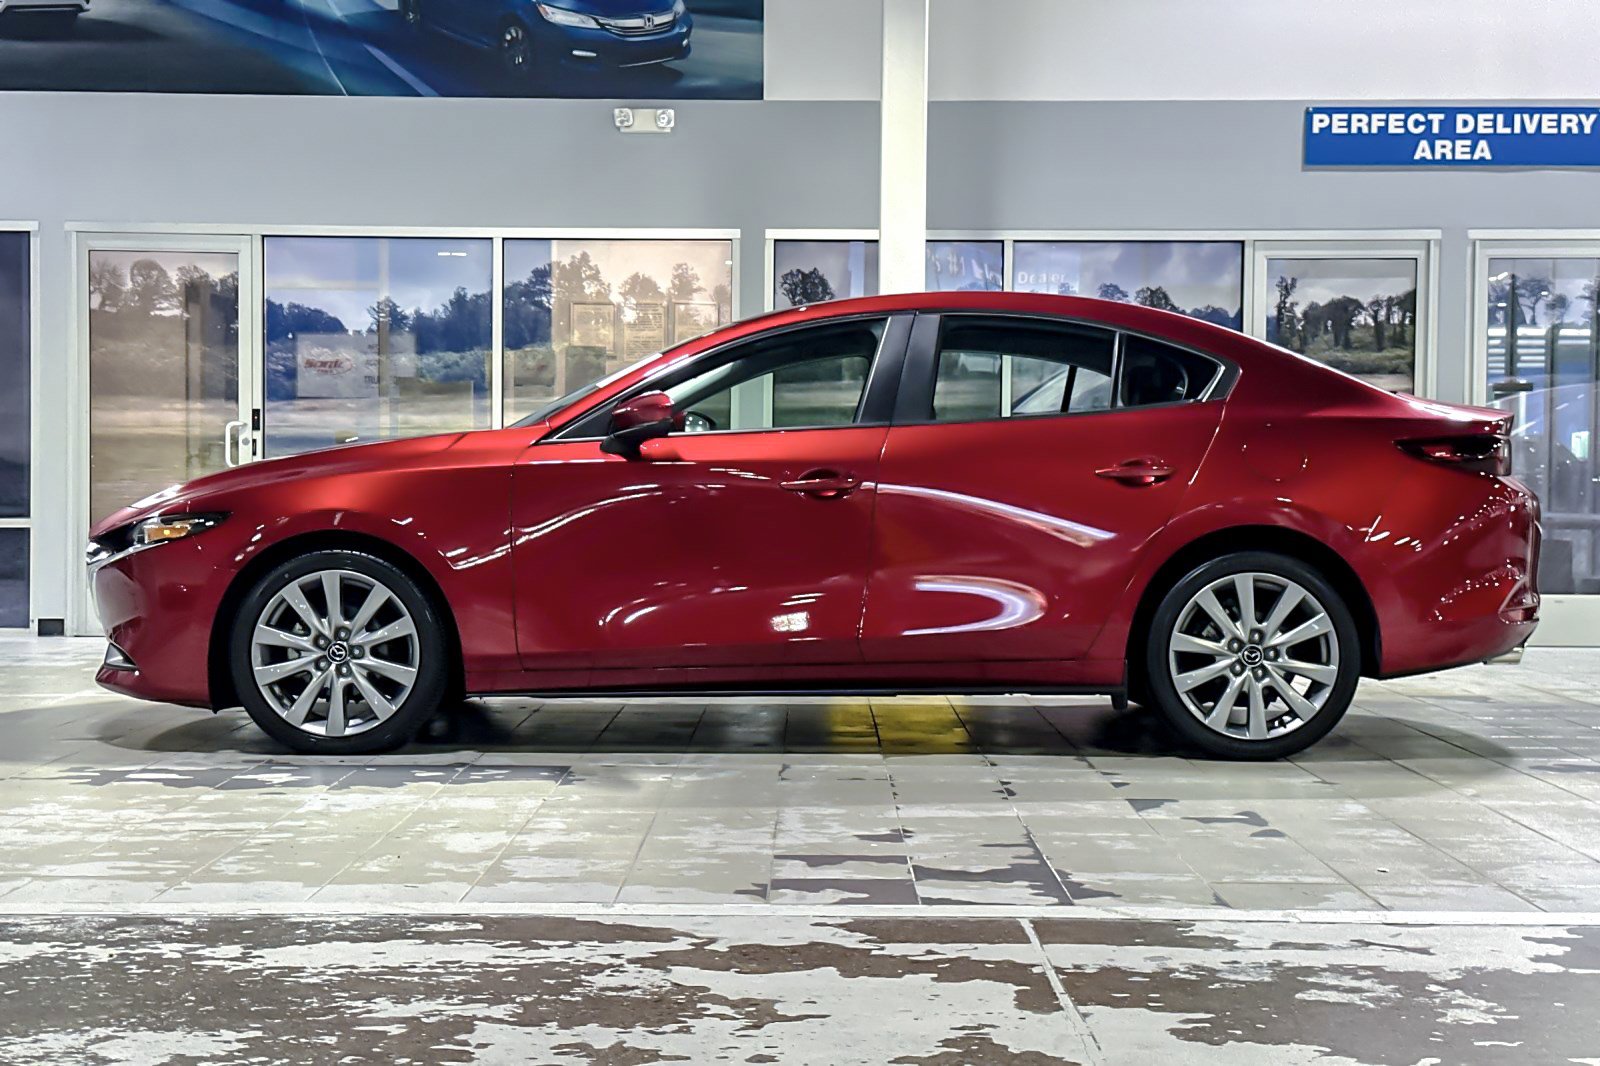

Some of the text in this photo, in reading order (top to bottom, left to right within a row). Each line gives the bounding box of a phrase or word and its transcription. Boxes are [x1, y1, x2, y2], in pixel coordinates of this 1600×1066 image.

[1311, 113, 1598, 135] PERFECT DELIVERY
[1413, 139, 1493, 160] AREA
[1017, 271, 1066, 285] Deaer
